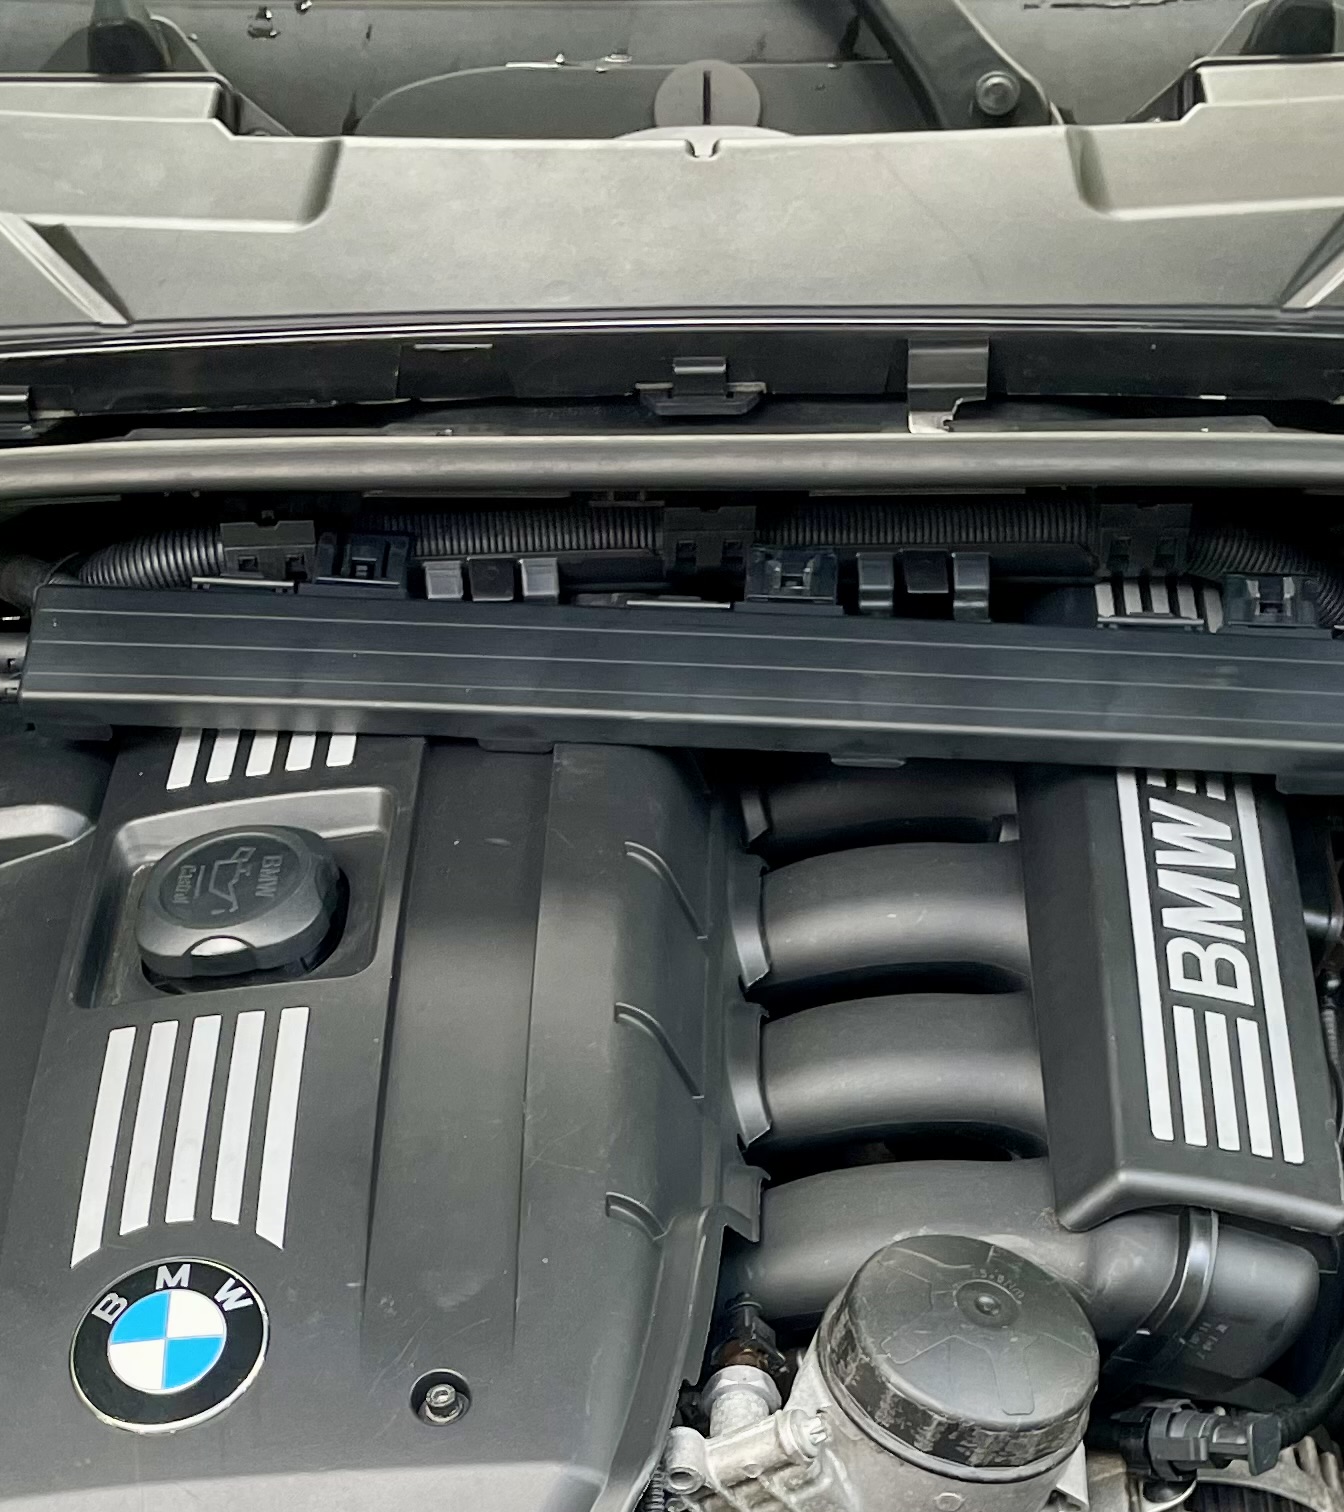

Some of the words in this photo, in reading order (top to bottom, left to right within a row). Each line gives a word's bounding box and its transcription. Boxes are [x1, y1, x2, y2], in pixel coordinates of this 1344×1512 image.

[172, 864, 197, 904] Castrol
[255, 855, 283, 897] BMW
[1148, 797, 1254, 1006] BMW
[92, 1263, 254, 1325] BMW
